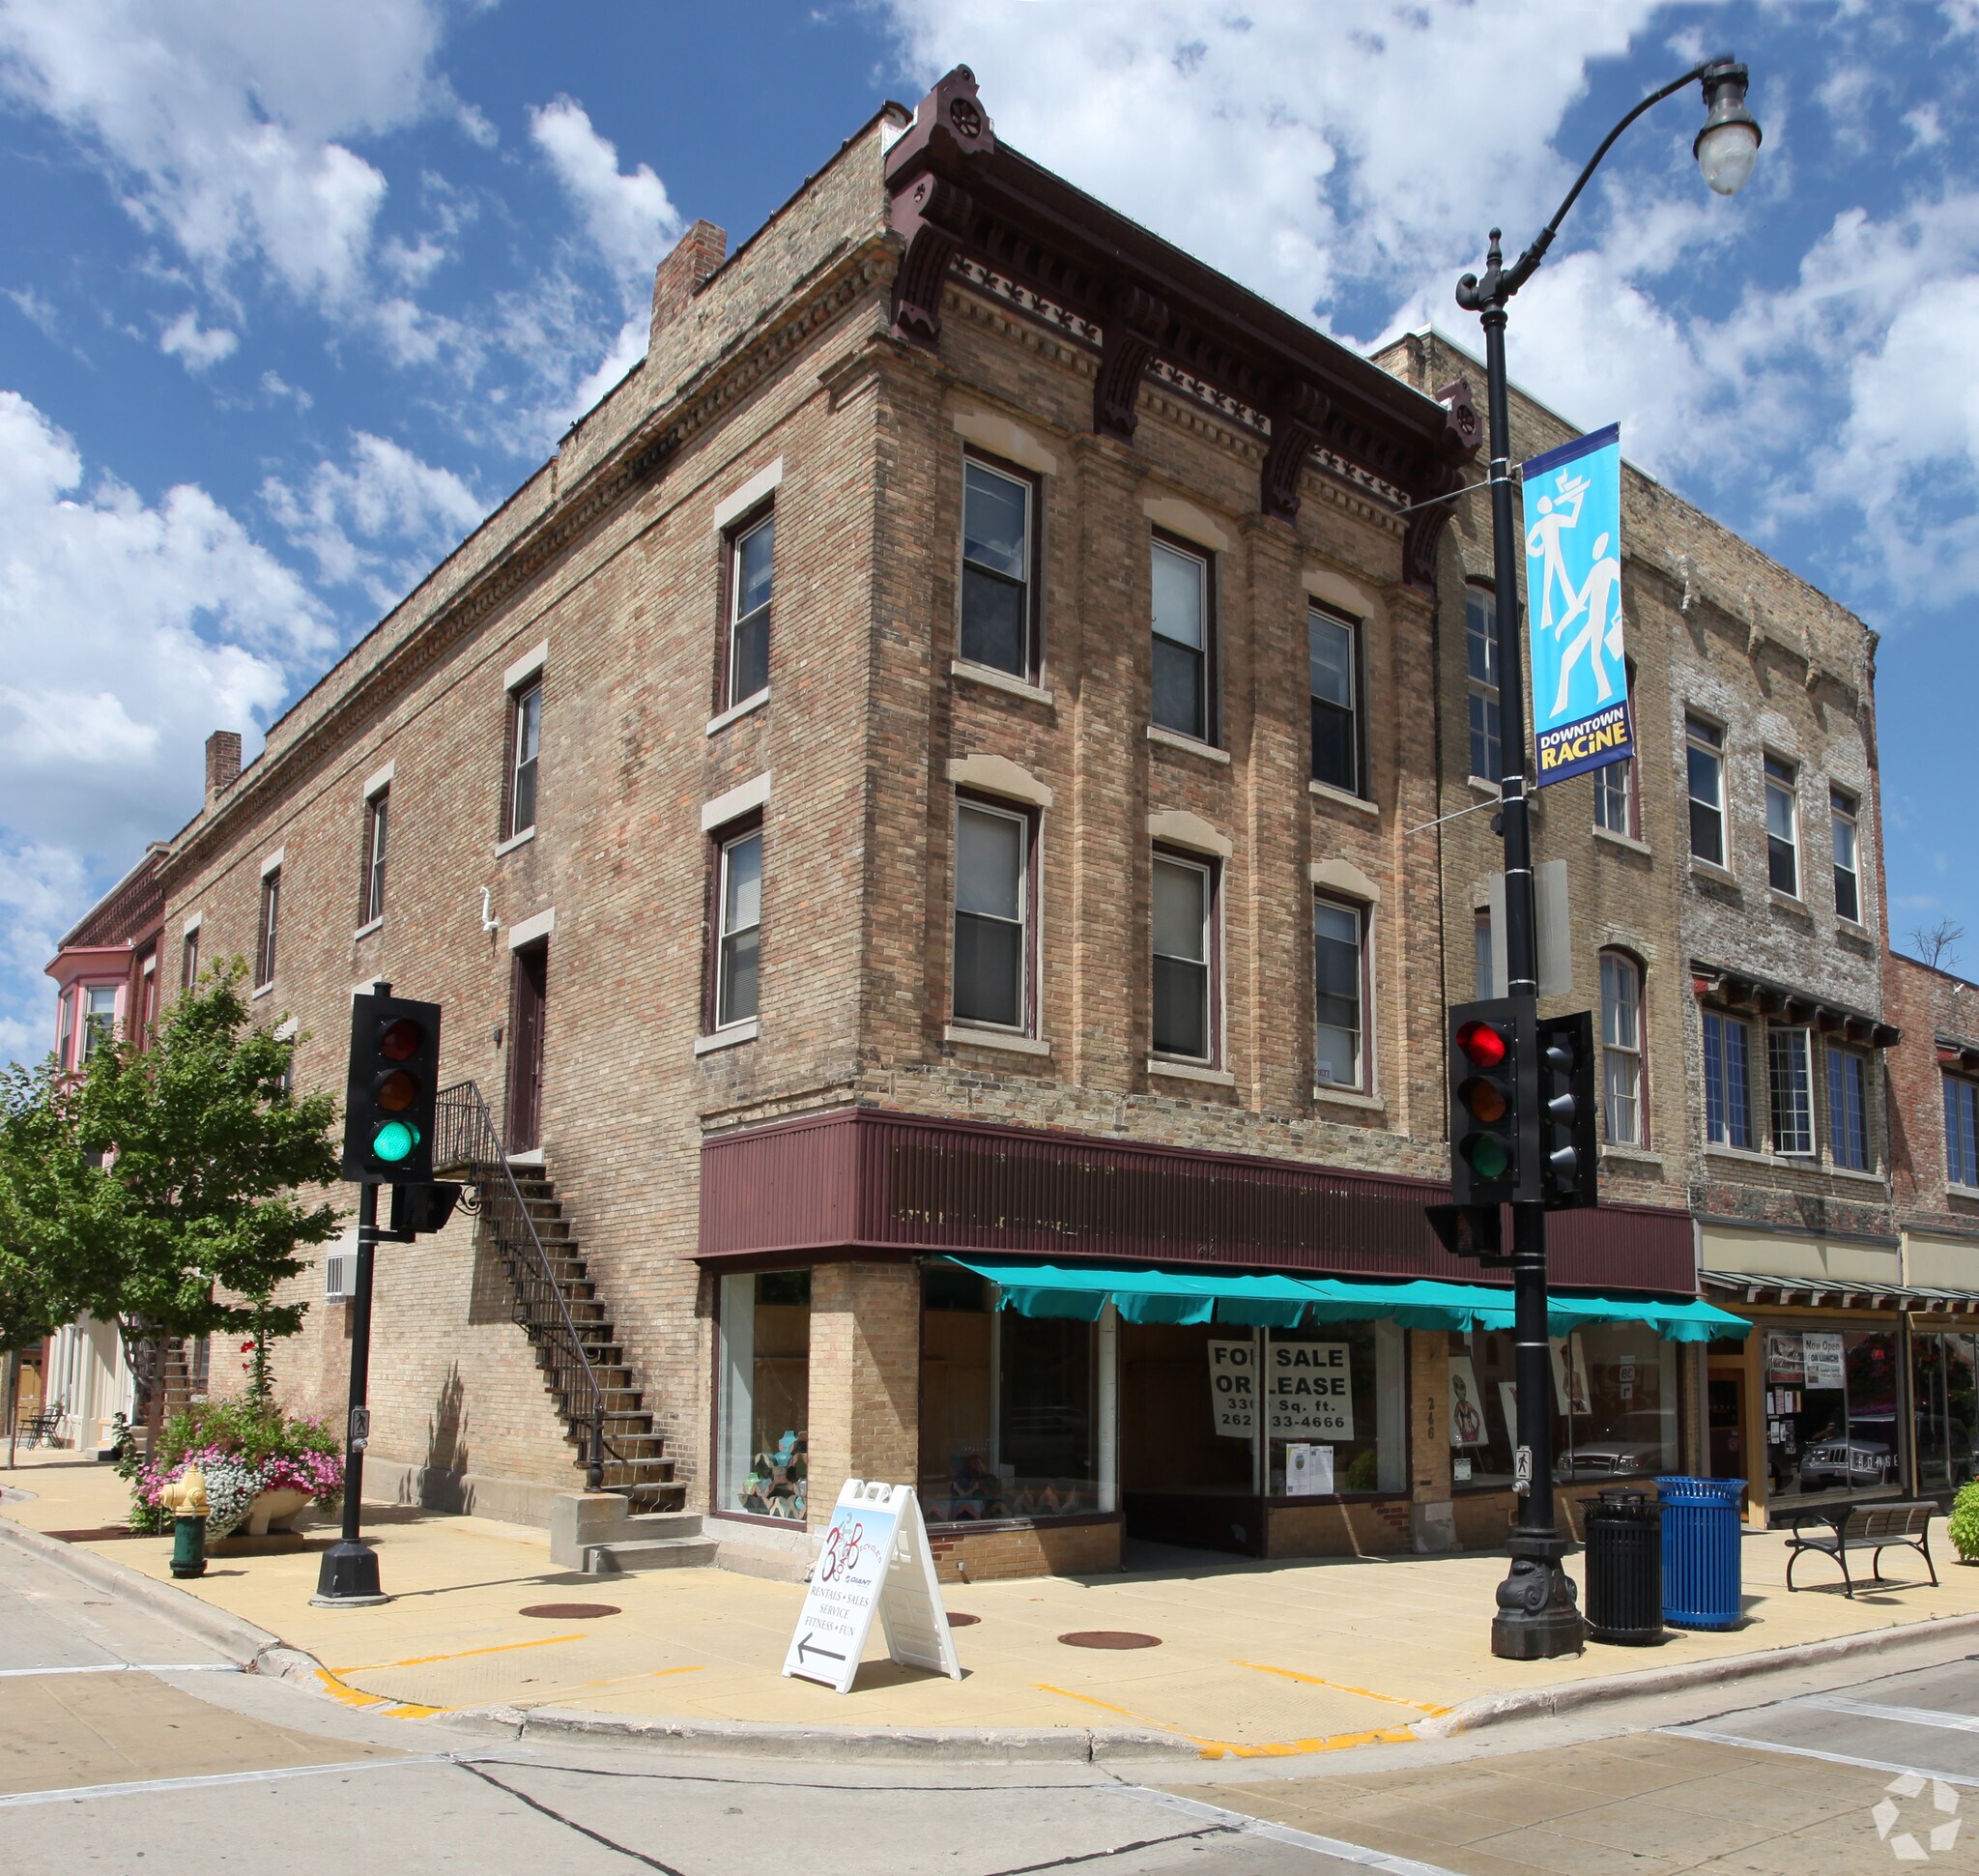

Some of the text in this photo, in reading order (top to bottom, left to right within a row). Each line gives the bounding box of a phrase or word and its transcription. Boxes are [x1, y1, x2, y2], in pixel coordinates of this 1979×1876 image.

[1540, 707, 1624, 749] DOWNTOWN
[1806, 1341, 1841, 1351] Now Open
[1276, 1348, 1344, 1368] SALE
[1279, 1400, 1306, 1413] Sq.
[1315, 1400, 1335, 1411] ft.
[850, 1576, 872, 1585] GIANT
[811, 1586, 870, 1607] RENTALS SALES
[819, 1603, 849, 1619] SERVICE
[805, 1616, 856, 1636] FITNESS FUN
